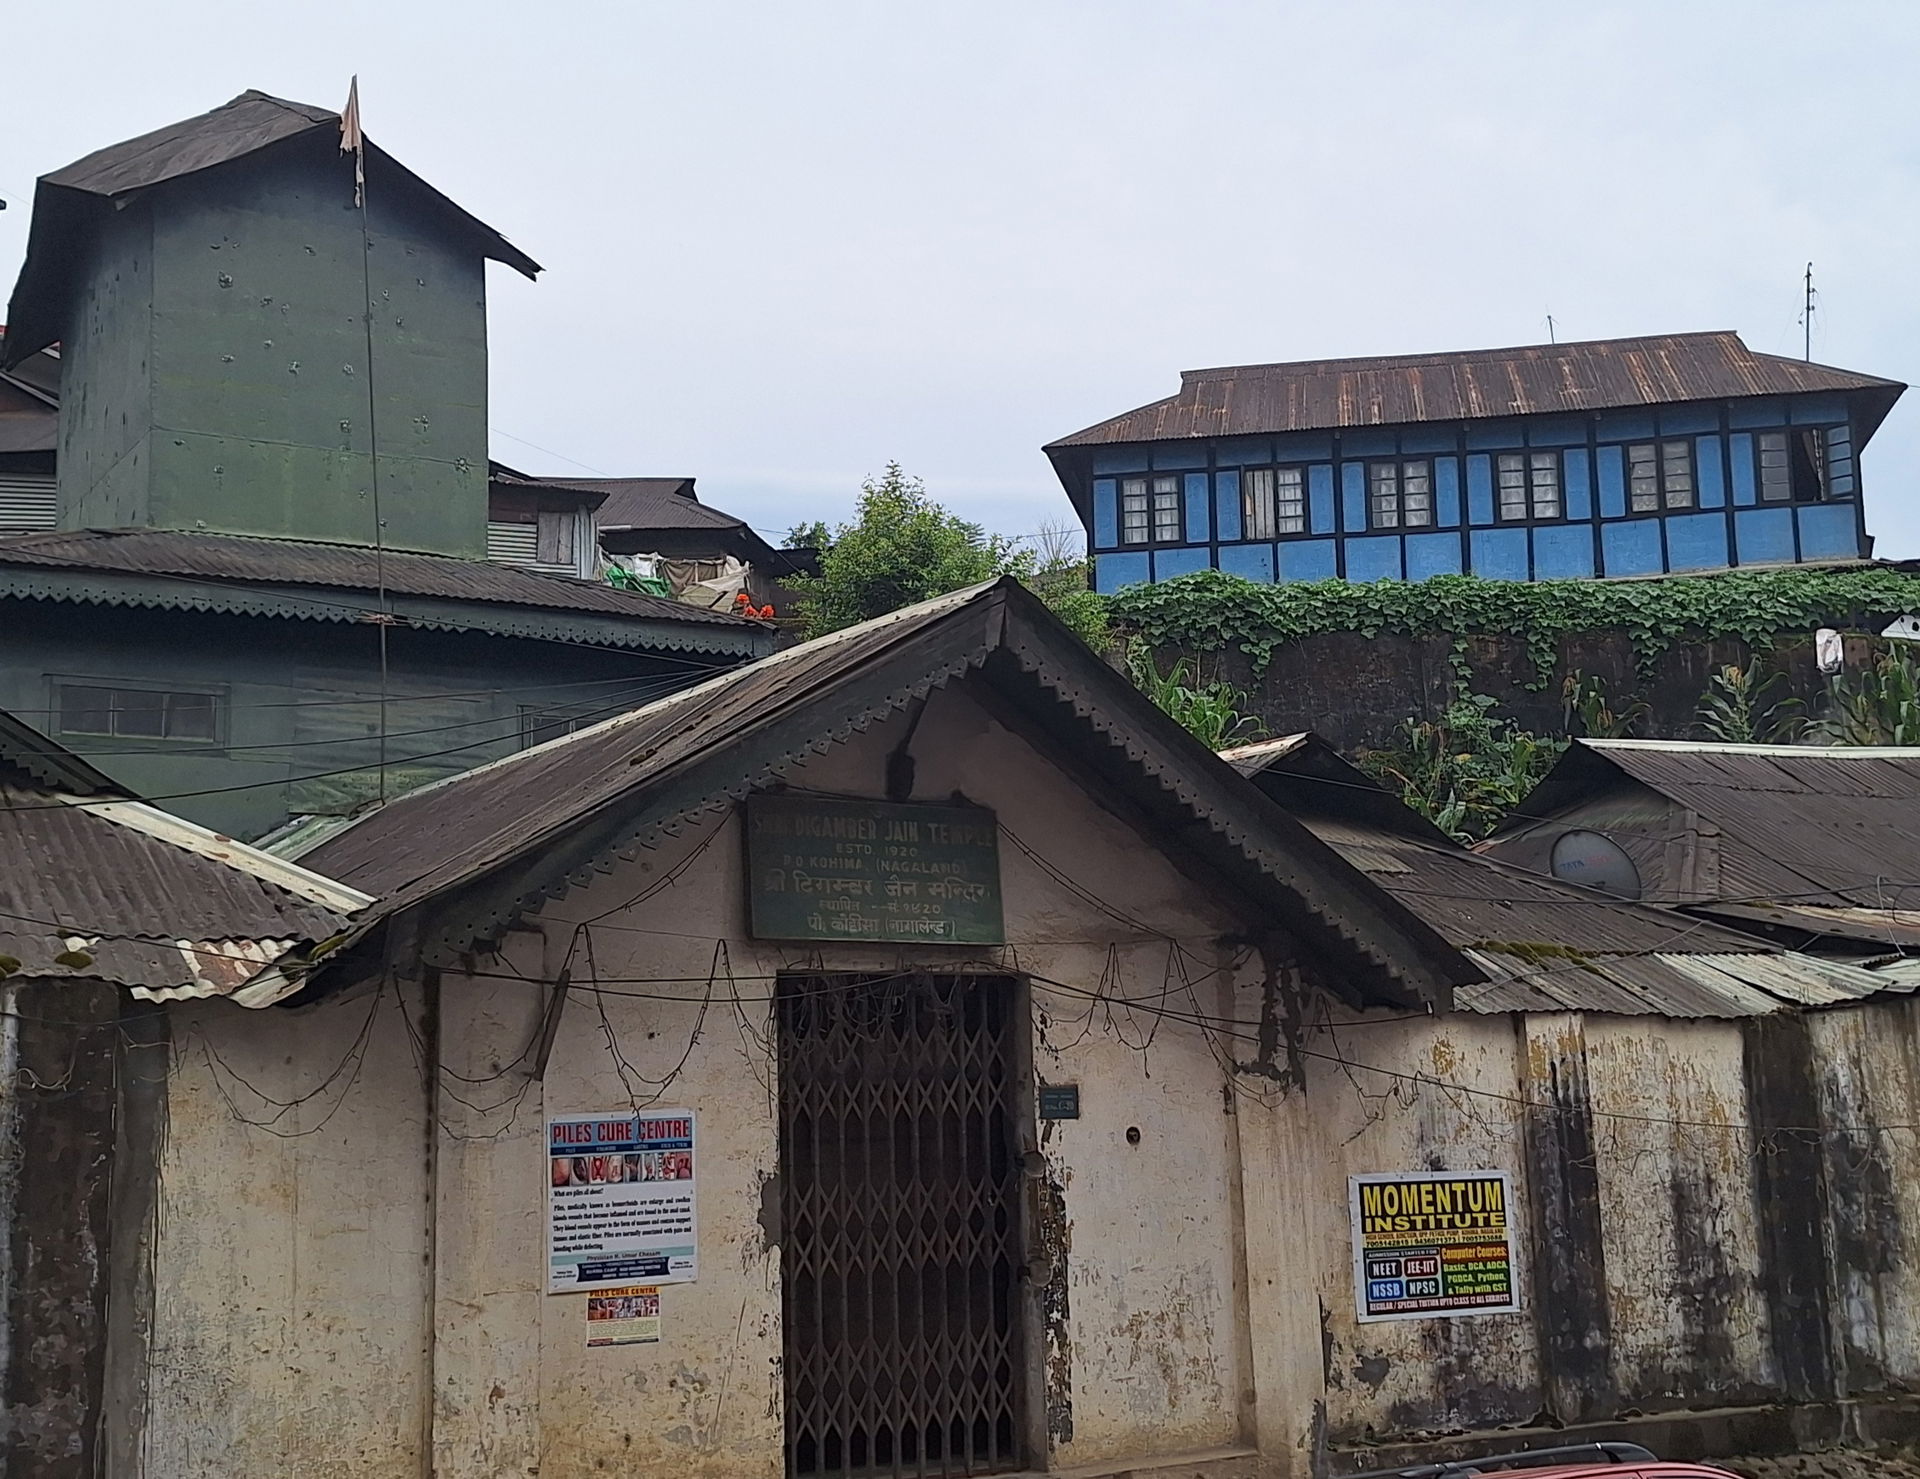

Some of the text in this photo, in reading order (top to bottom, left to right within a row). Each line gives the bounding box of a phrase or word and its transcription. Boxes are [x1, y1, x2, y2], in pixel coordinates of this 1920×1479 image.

[885, 820, 919, 842] JAIN
[885, 846, 918, 856] 1920
[553, 1120, 690, 1144] PILES CURE CENTRE
[1363, 1181, 1501, 1216] MOMENTUM
[1366, 1212, 1505, 1232] INSTITUTE
[1442, 1248, 1476, 1260] Computer
[1372, 1260, 1434, 1276] NEET JEE-IIT
[1372, 1281, 1435, 1297] NSSB NPSC
[1455, 1286, 1473, 1294] Tally
[1475, 1284, 1492, 1293] with
[1492, 1283, 1507, 1291] GST
[1370, 1302, 1393, 1311] REGULAR
[1397, 1300, 1418, 1309] SPECIAL
[1453, 1296, 1469, 1305] CLASS
[1485, 1294, 1510, 1303] SUBJECTS
